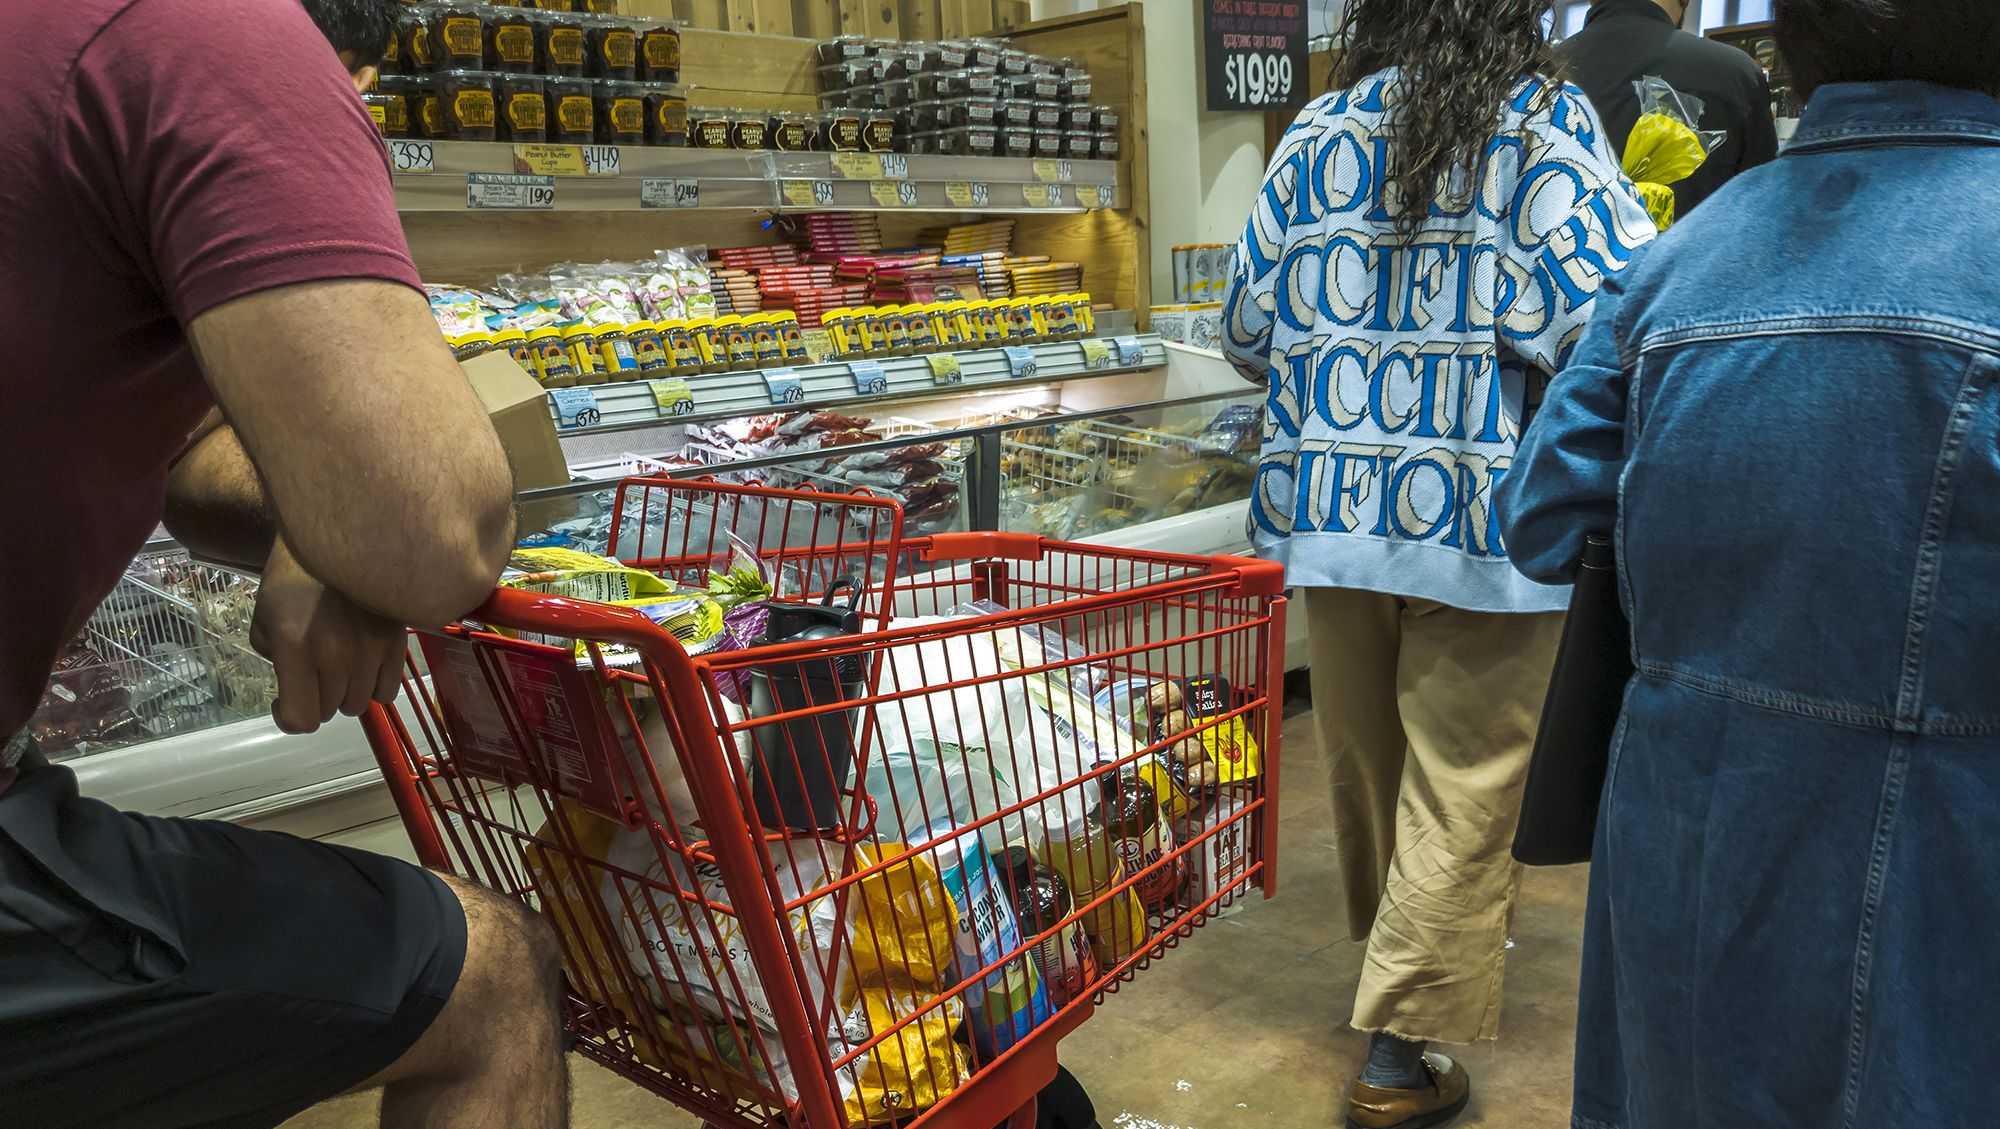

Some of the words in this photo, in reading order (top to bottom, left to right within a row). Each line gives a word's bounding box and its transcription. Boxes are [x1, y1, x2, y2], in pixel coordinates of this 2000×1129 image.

[1225, 52, 1292, 104] $19.99
[959, 881, 1001, 933] CCONUT
[977, 904, 1005, 943] WATR
